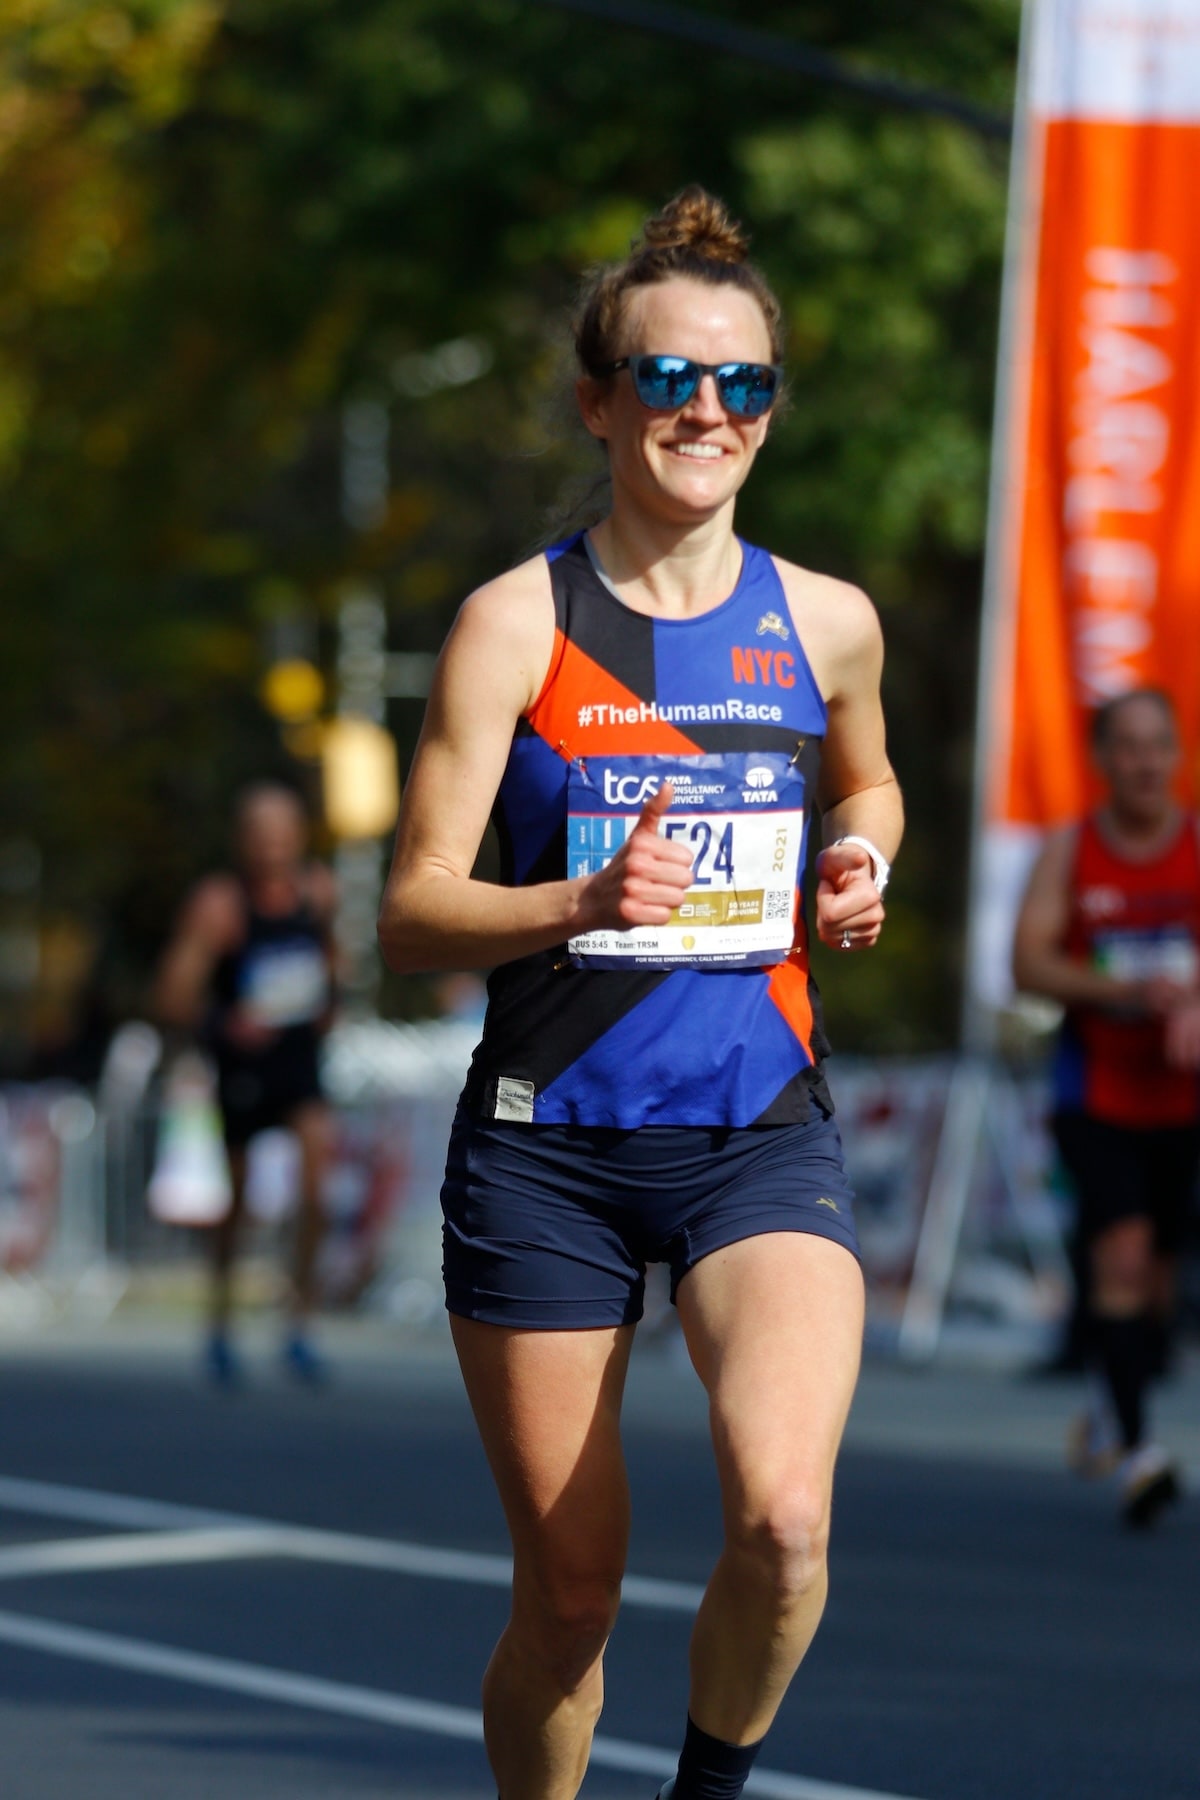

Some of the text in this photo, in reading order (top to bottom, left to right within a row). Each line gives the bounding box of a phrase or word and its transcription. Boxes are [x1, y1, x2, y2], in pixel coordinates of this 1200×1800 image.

[1063, 245, 1179, 706] HARLEM
[731, 646, 796, 689] NYC
[577, 699, 782, 727] #TheHumanRace
[604, 768, 660, 805] tcs
[673, 785, 726, 795] ONSULTANCY
[742, 790, 779, 804] TATA
[672, 795, 705, 805] ERVICES
[773, 828, 788, 872] 2021
[740, 900, 759, 909] YEARS
[575, 940, 659, 949] BUS 5:45 Team: TRSM
